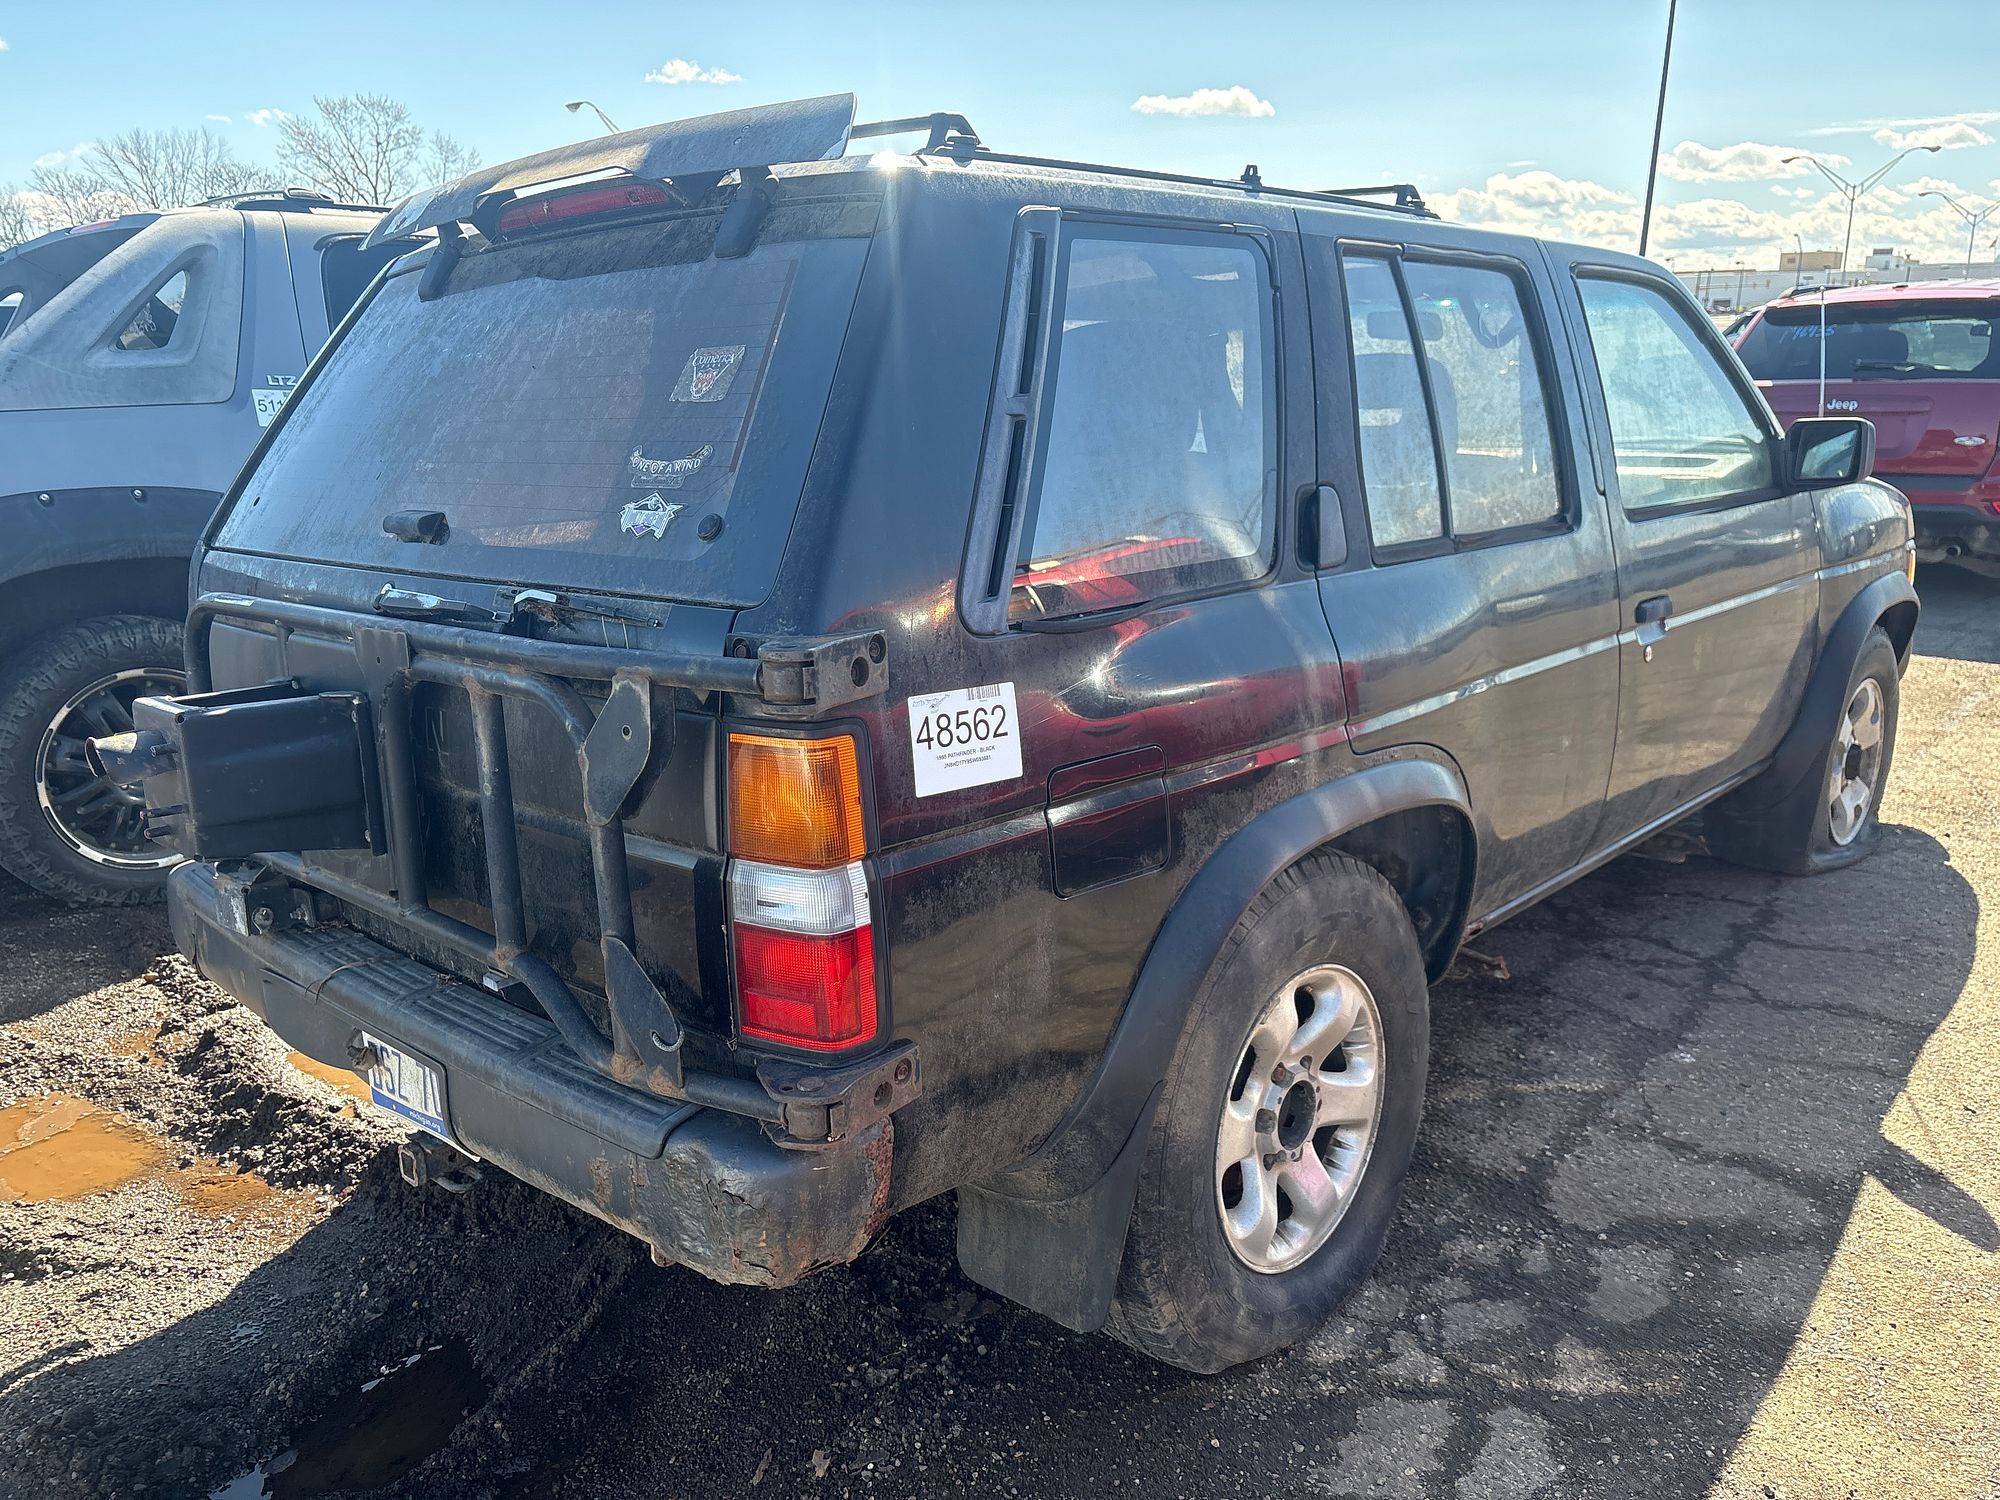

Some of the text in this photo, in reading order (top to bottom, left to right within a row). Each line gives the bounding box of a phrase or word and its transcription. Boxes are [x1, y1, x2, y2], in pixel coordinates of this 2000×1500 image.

[266, 374, 298, 386] LTZ
[1826, 399, 1858, 411] Jeep
[632, 456, 701, 474] ONE OF A KIND
[916, 704, 1008, 750] 48562
[948, 748, 977, 759] PATHFINDER
[980, 745, 996, 753] BLACK
[409, 1110, 441, 1133] michigan.org
